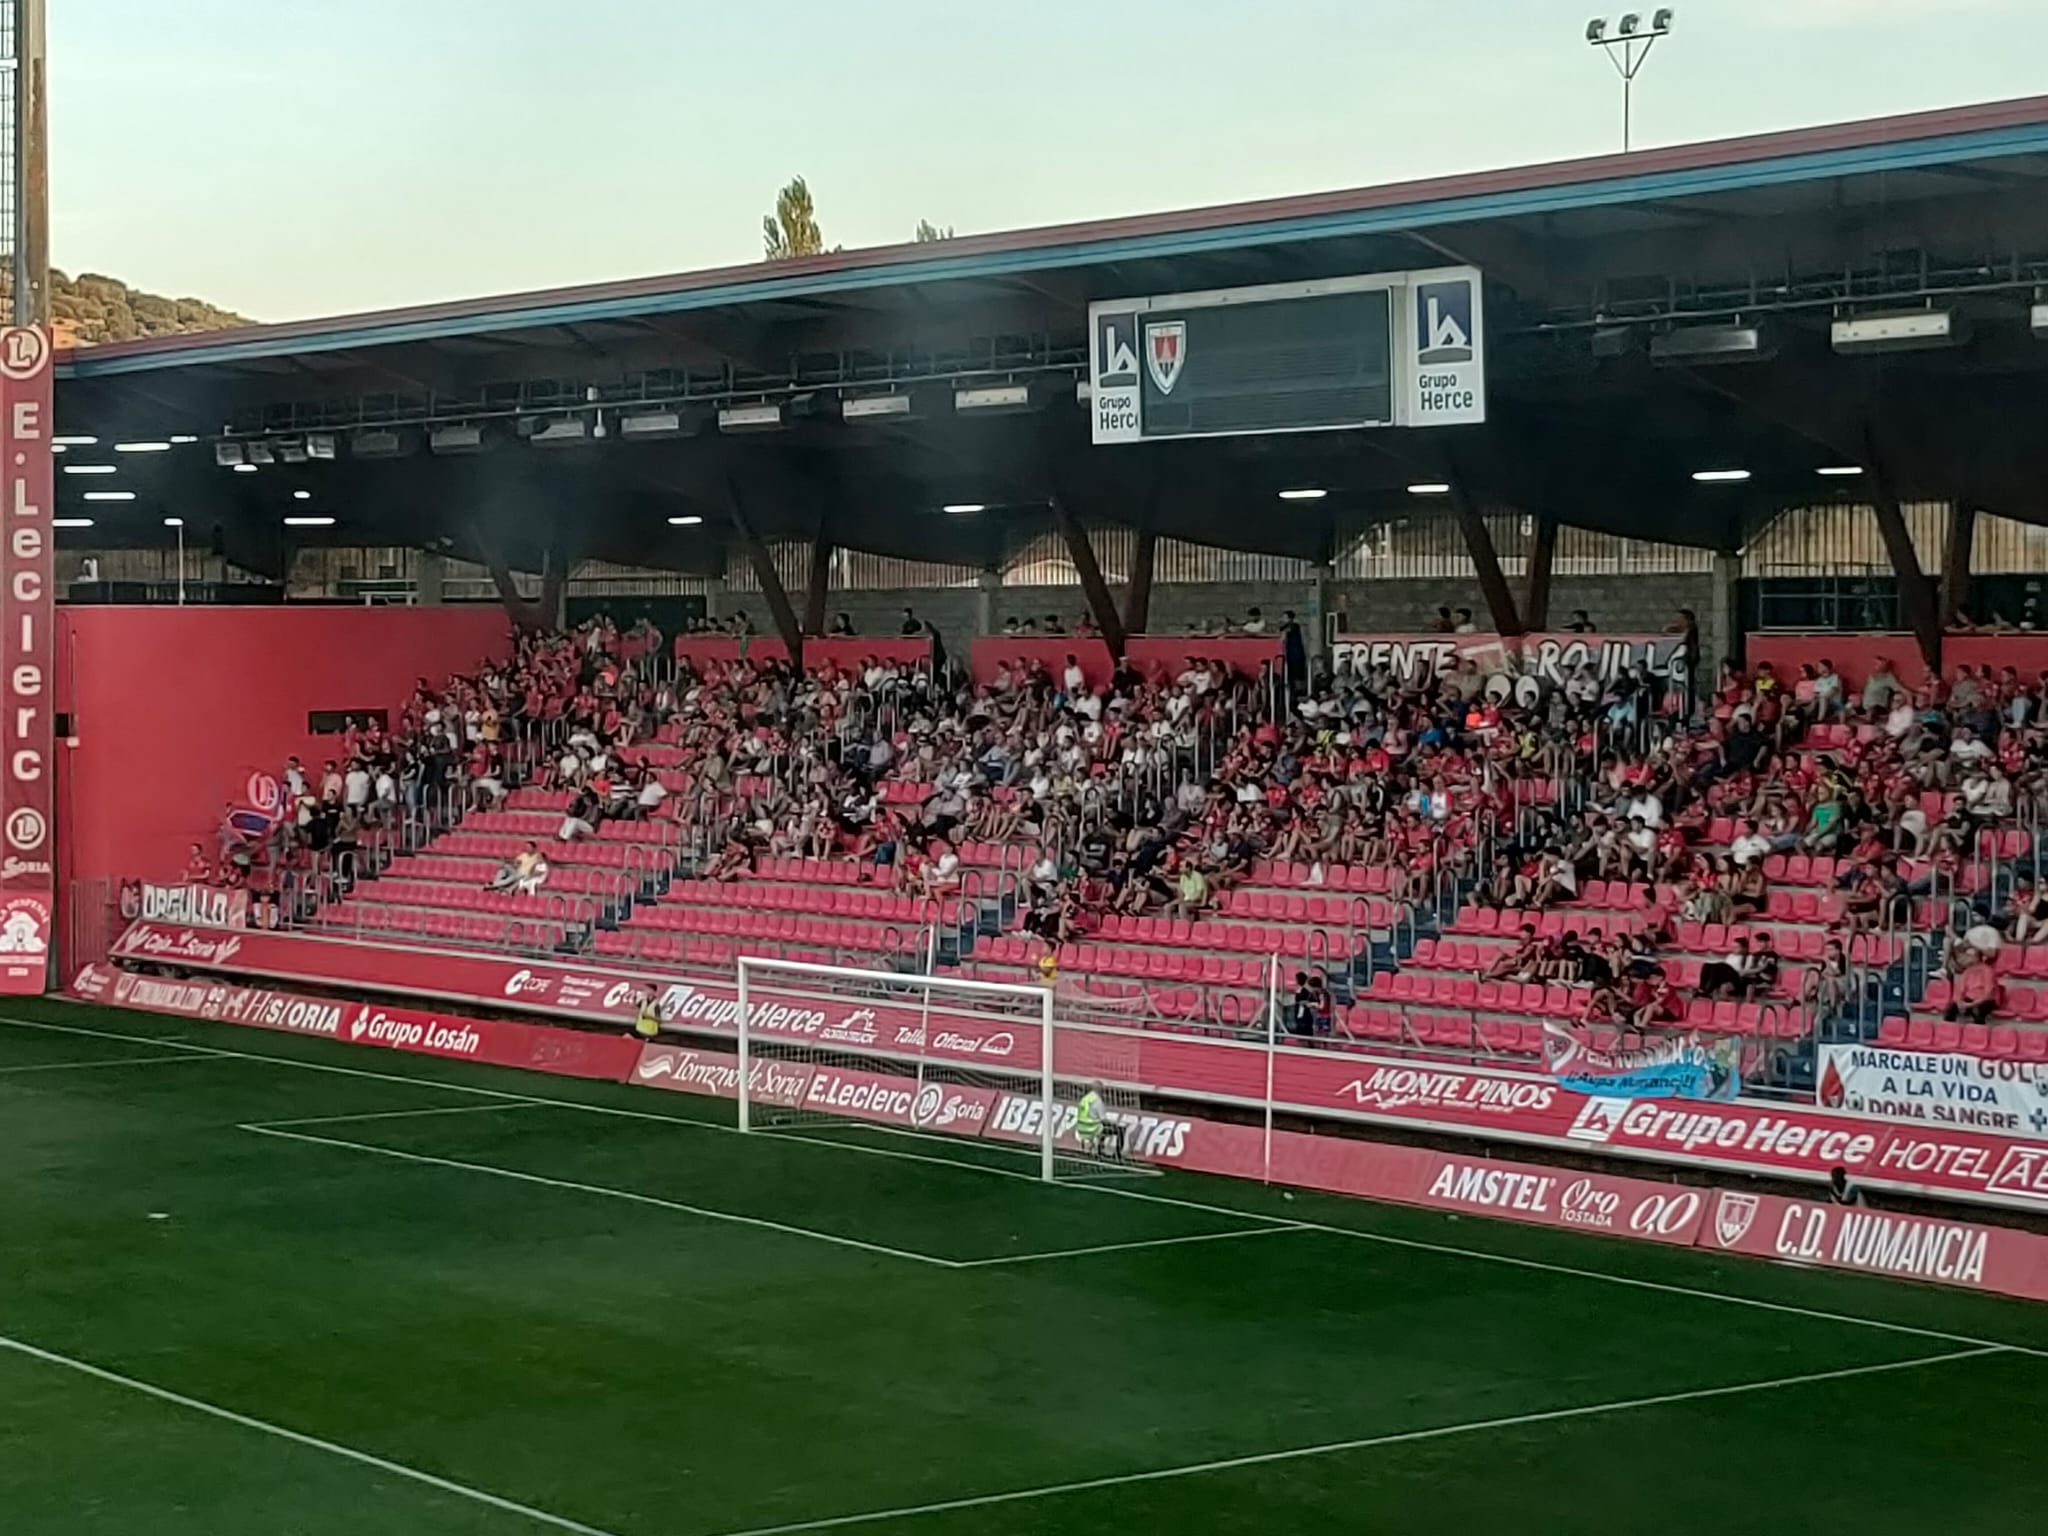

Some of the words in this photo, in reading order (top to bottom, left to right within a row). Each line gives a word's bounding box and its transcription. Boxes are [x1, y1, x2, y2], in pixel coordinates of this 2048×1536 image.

[1417, 373, 1458, 392] Grupo
[1099, 397, 1131, 412] Grupo
[1420, 388, 1473, 412] Herce
[1332, 641, 1458, 680] FRENTE
[143, 884, 228, 925] ORGULLO
[368, 1012, 422, 1048] Grupo
[423, 1019, 480, 1054] Losán
[750, 1001, 826, 1033] Herce
[758, 1063, 806, 1097] Soria
[1851, 1051, 1938, 1074] MARCALE
[1941, 1057, 1968, 1077] UN
[1365, 1067, 1466, 1098] MONTE
[1465, 1079, 1558, 1110] PINOS
[1882, 1077, 1898, 1094] A
[1906, 1079, 1934, 1098] LA
[1941, 1081, 2000, 1105] VIDA
[1932, 1104, 2021, 1129] SANGRE
[1622, 1103, 1746, 1150] Grupo
[1743, 1115, 1876, 1165] Herce
[1879, 1138, 1992, 1180] HOTEL
[1429, 1163, 1550, 1213] AMSTEL
[1560, 1178, 1621, 1216] Oro
[1560, 1208, 1613, 1228] TOSTADA
[1775, 1204, 1824, 1259] C.D.
[1832, 1212, 1988, 1284] NUMANCIA
